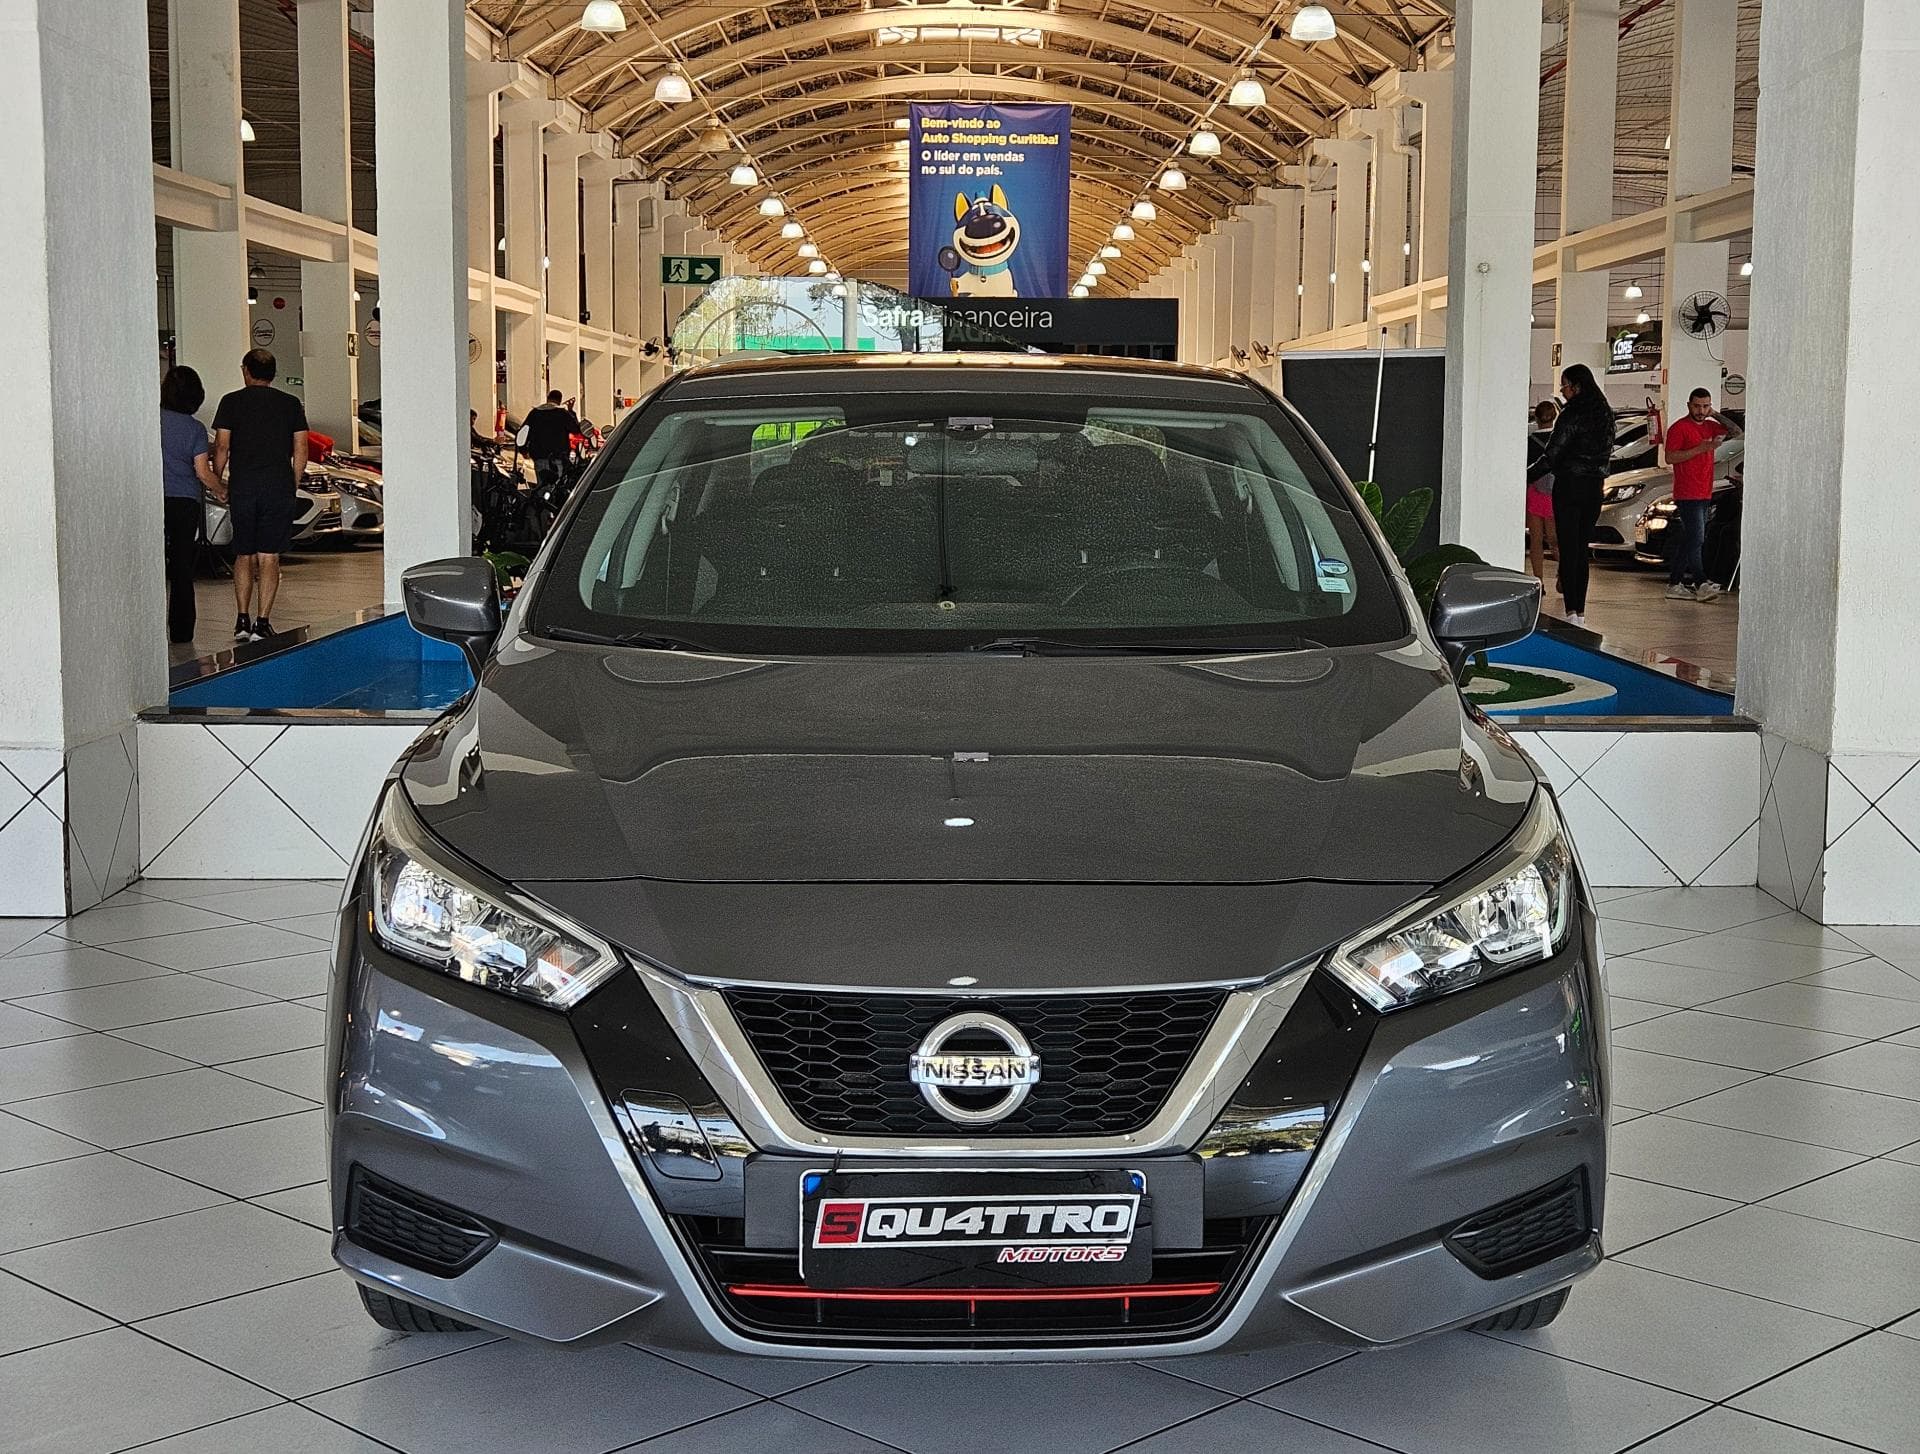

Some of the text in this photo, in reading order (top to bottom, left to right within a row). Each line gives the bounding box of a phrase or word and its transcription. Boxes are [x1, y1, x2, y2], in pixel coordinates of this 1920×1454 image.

[921, 117, 1001, 129] Bem-vindo ao
[921, 133, 949, 144] Auto
[952, 133, 1006, 145] Shopping
[921, 150, 1025, 161] O líder em vendas
[921, 164, 1003, 176] no sul do país.
[862, 305, 1053, 328] Safra inanceira
[925, 1062, 1026, 1079] NISSAN
[997, 1246, 1126, 1263] MOTORS
